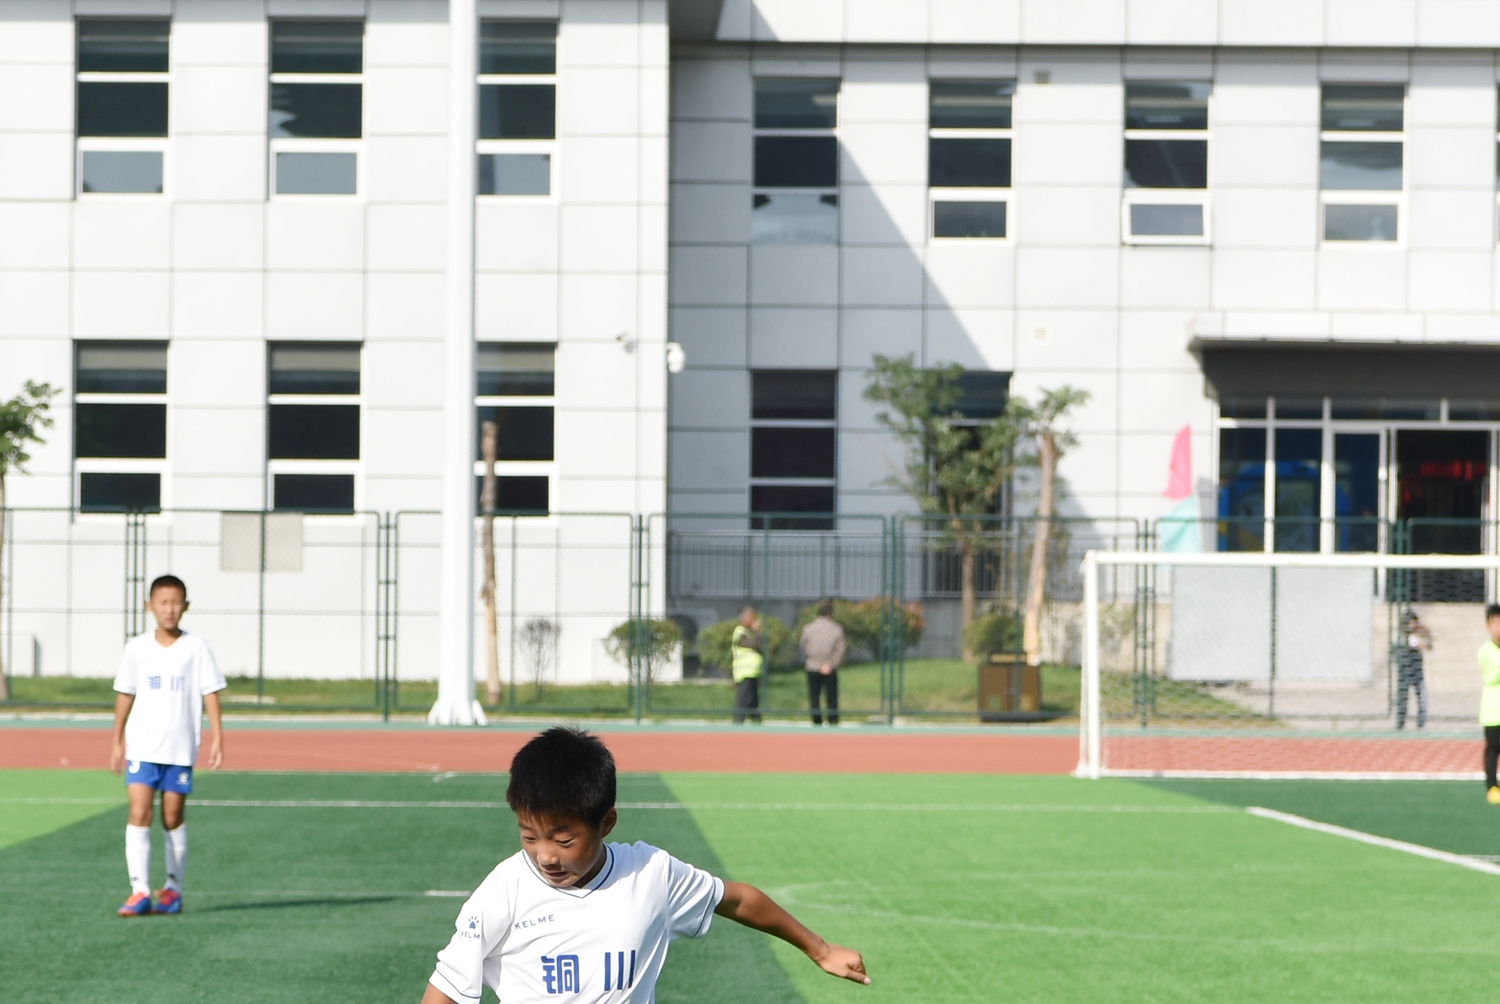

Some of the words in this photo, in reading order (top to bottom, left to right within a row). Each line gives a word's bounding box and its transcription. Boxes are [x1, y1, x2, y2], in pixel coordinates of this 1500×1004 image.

[514, 913, 556, 931] KELME
[461, 931, 481, 940] KELM
[540, 949, 636, 995] 铜川
